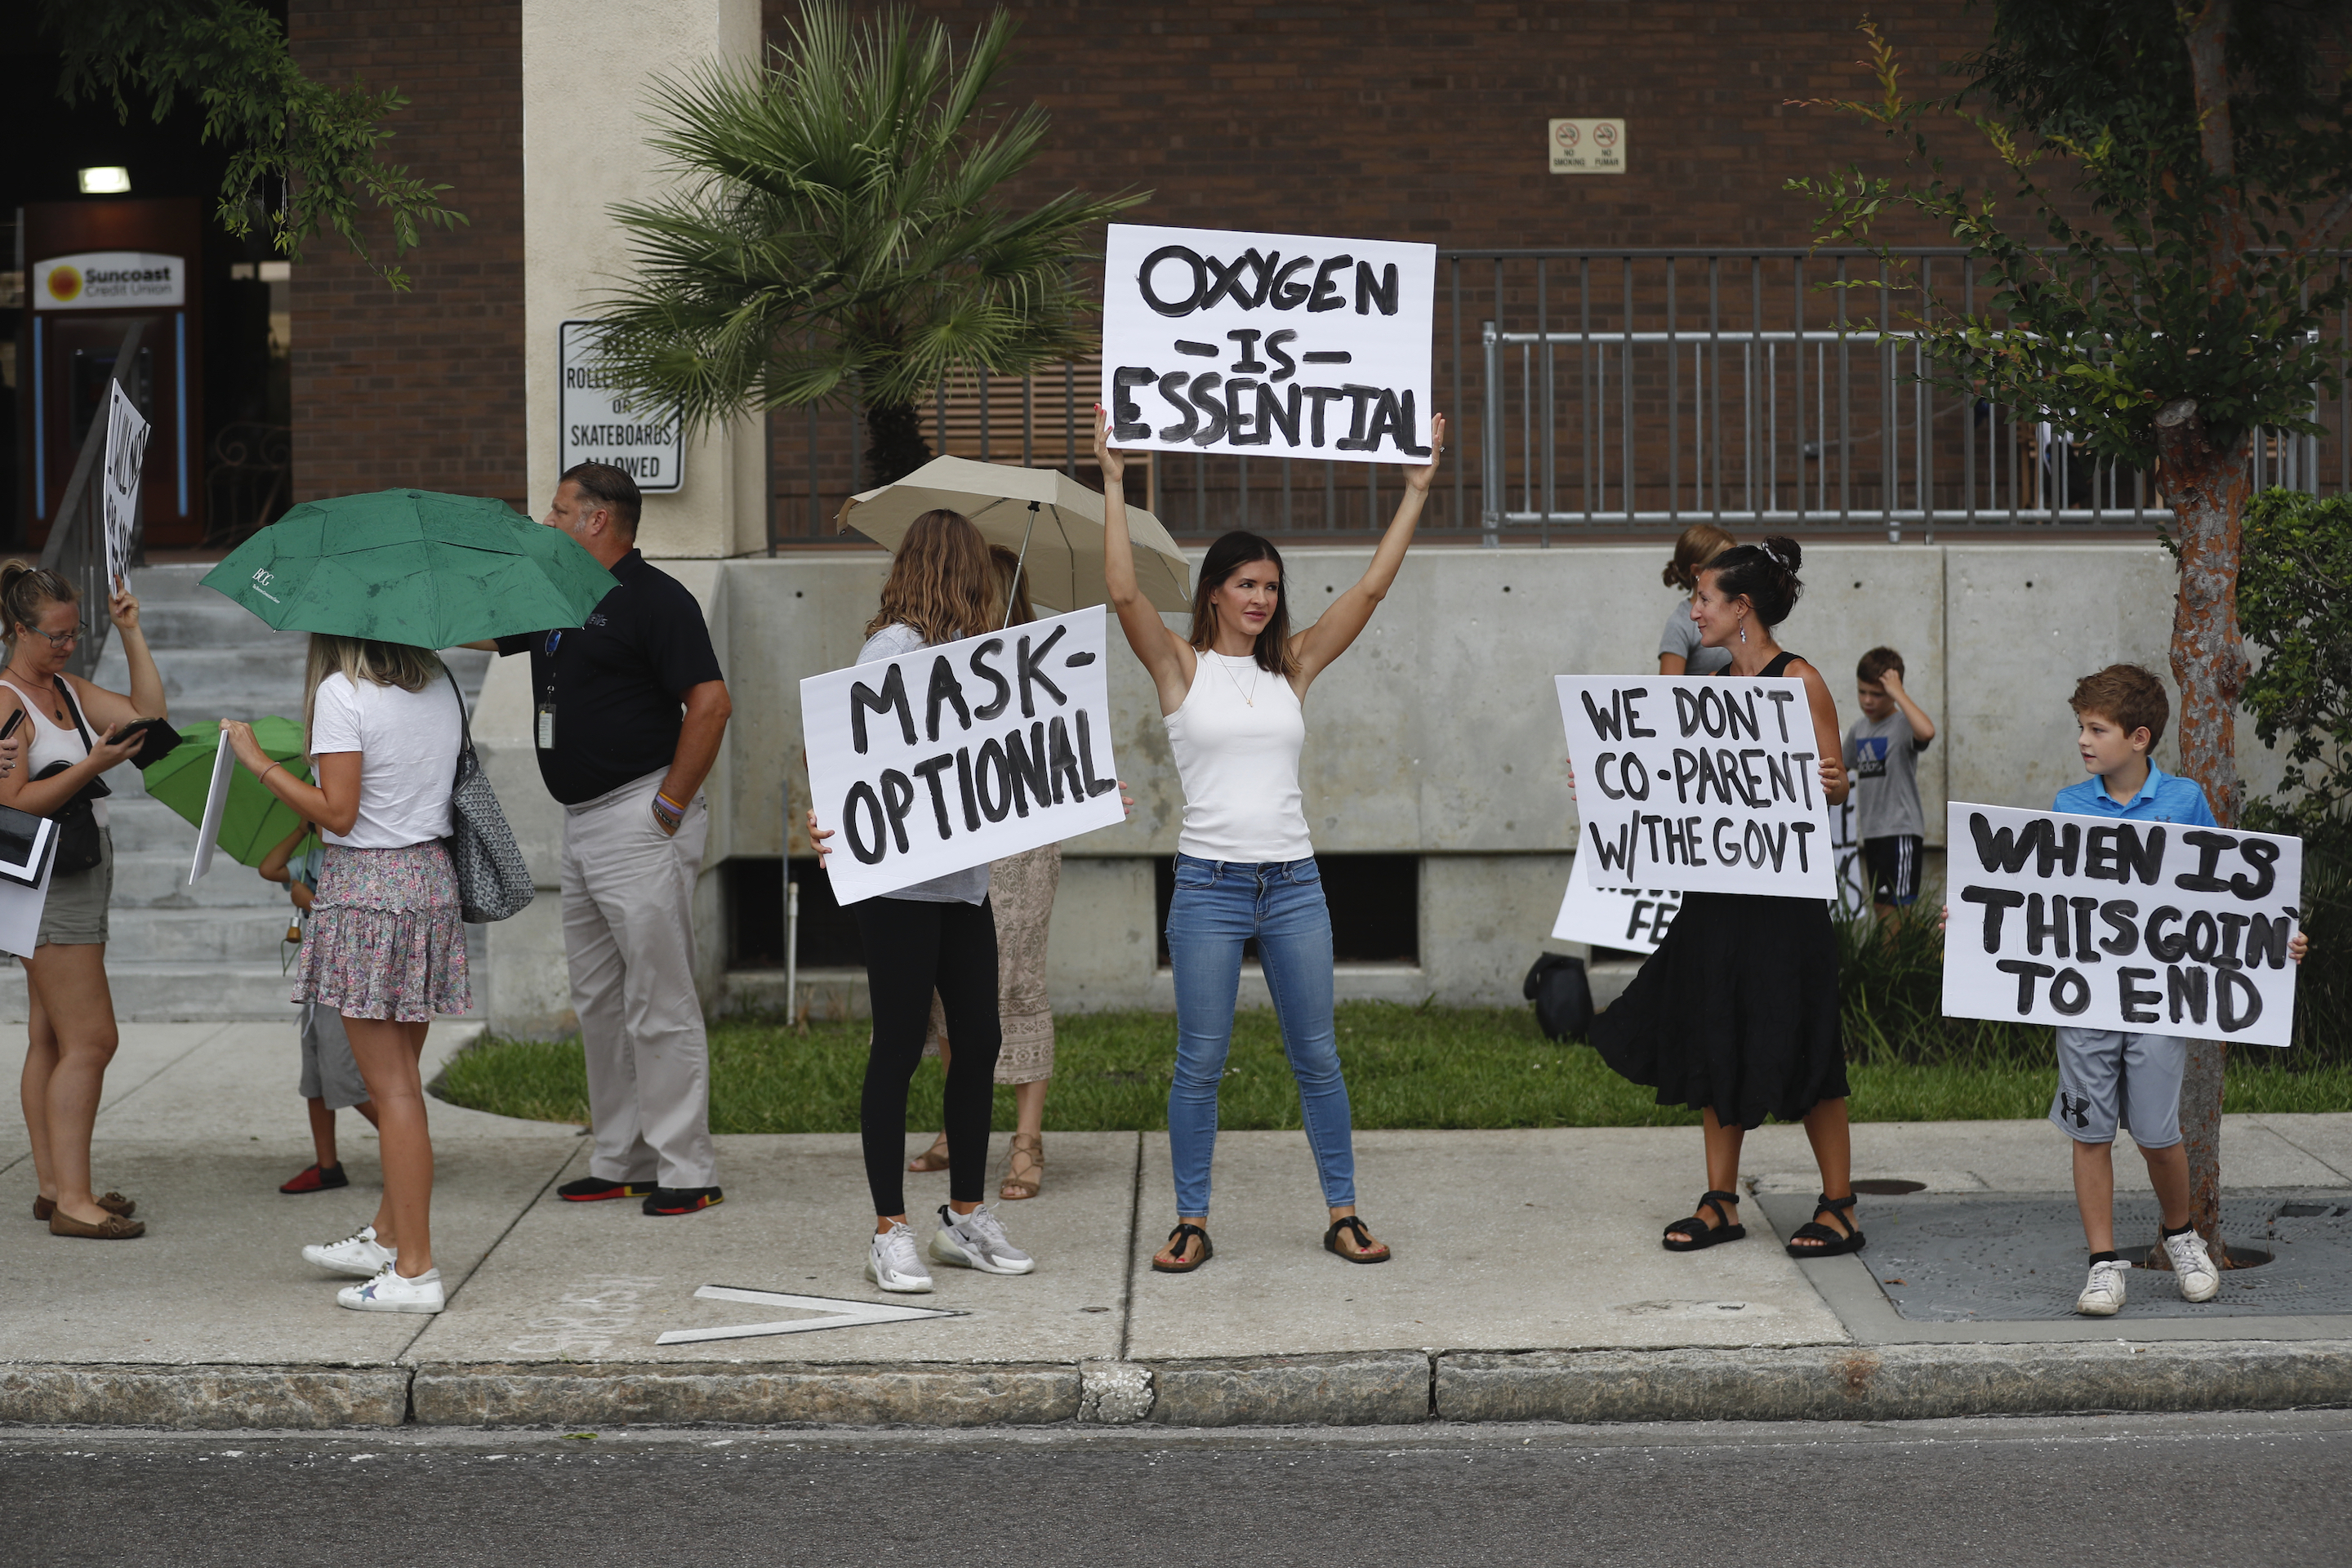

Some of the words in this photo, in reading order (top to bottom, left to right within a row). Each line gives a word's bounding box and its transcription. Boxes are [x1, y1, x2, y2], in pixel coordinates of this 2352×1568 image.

[1553, 158, 1585, 167] SMOKING
[85, 267, 172, 283] Suncoast
[1135, 245, 1399, 318] OXYGEN
[571, 424, 672, 446] SKATEBOARDS
[1113, 366, 1432, 457] ESSENTIAL
[252, 568, 274, 586] BCG
[850, 625, 1096, 755] MASK-
[1581, 688, 1656, 741] WE
[1672, 686, 1793, 743] DON'T
[842, 708, 1117, 864] OPTIONAL
[1713, 817, 1815, 873] GOVT
[1969, 813, 2167, 886] WHEN
[2175, 831, 2280, 901] IS
[1961, 885, 2140, 964] THIS
[1996, 959, 2091, 1017] TO
[2117, 964, 2263, 1033] END
